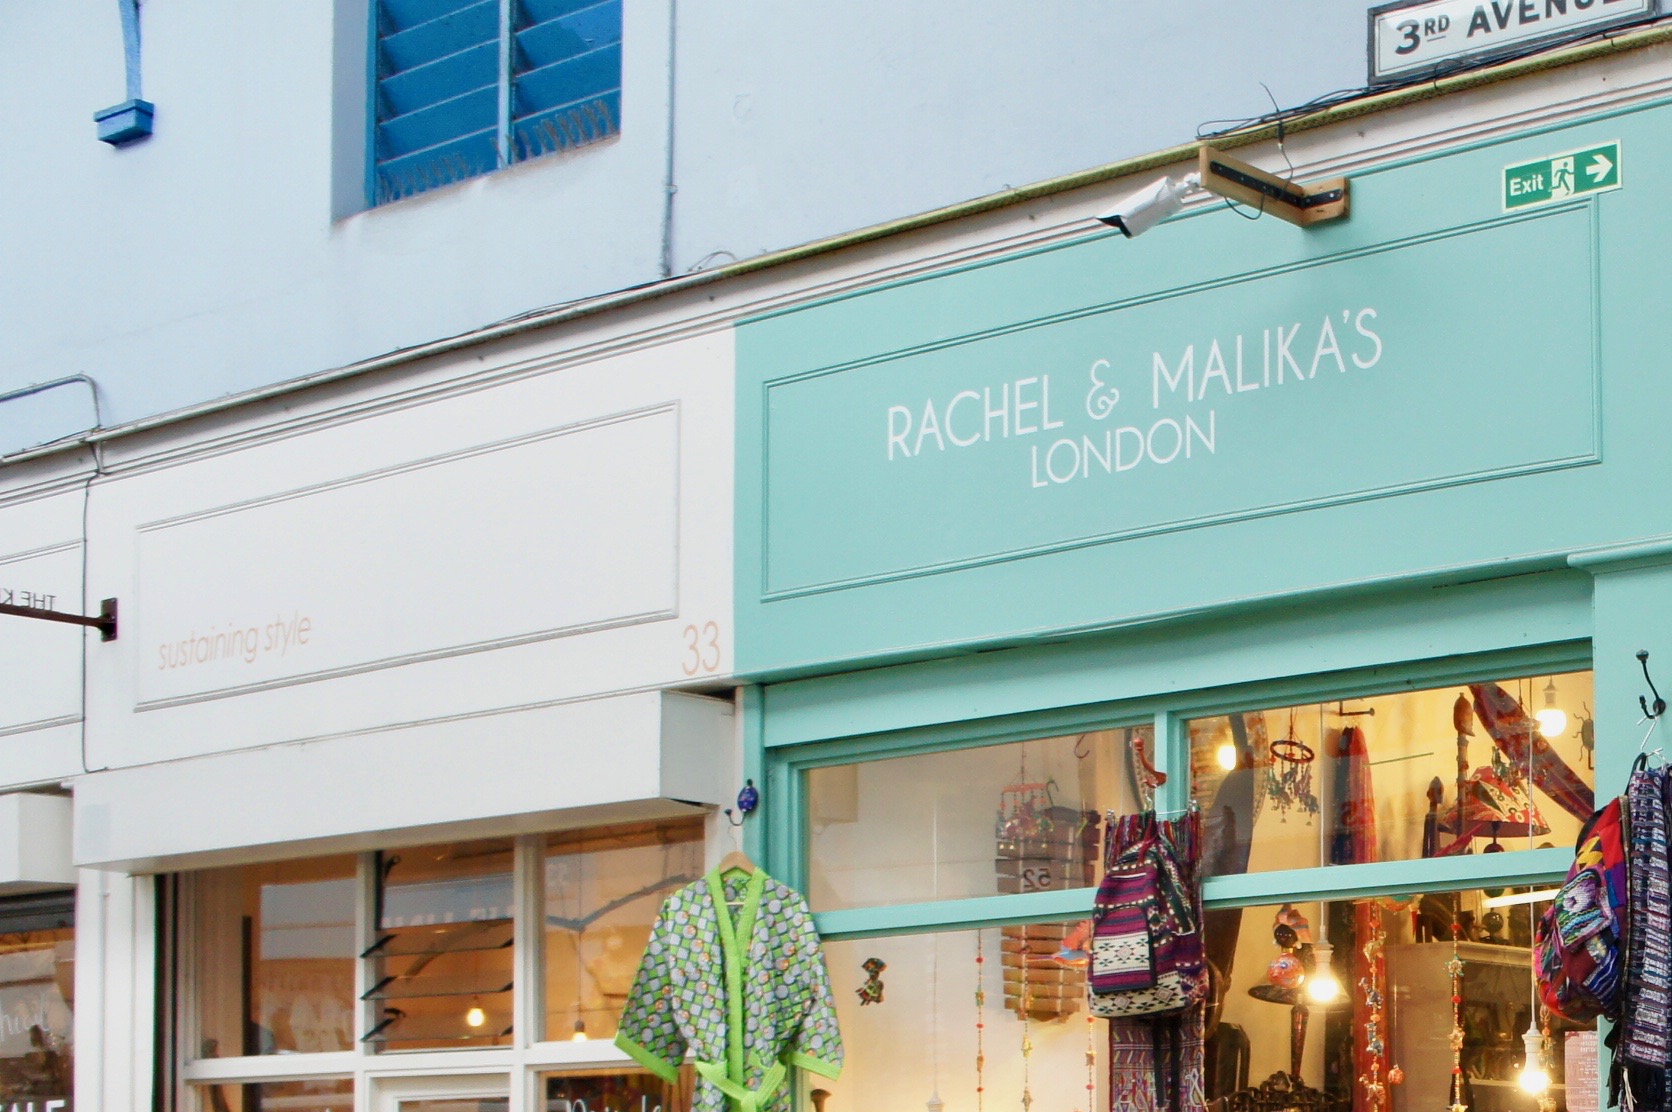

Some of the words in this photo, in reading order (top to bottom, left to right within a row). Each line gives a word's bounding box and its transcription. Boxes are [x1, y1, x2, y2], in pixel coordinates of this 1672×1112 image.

[1395, 14, 1450, 55] 3RD
[1467, 0, 1622, 38] AVEN
[1510, 174, 1544, 196] Exit
[887, 374, 1063, 461] RACHEL
[1086, 360, 1120, 420] &
[1152, 308, 1383, 409] MALIKA'S
[1032, 410, 1216, 489] LONDON
[158, 621, 259, 671] sustaining
[264, 609, 312, 657] style
[682, 620, 720, 676] 33
